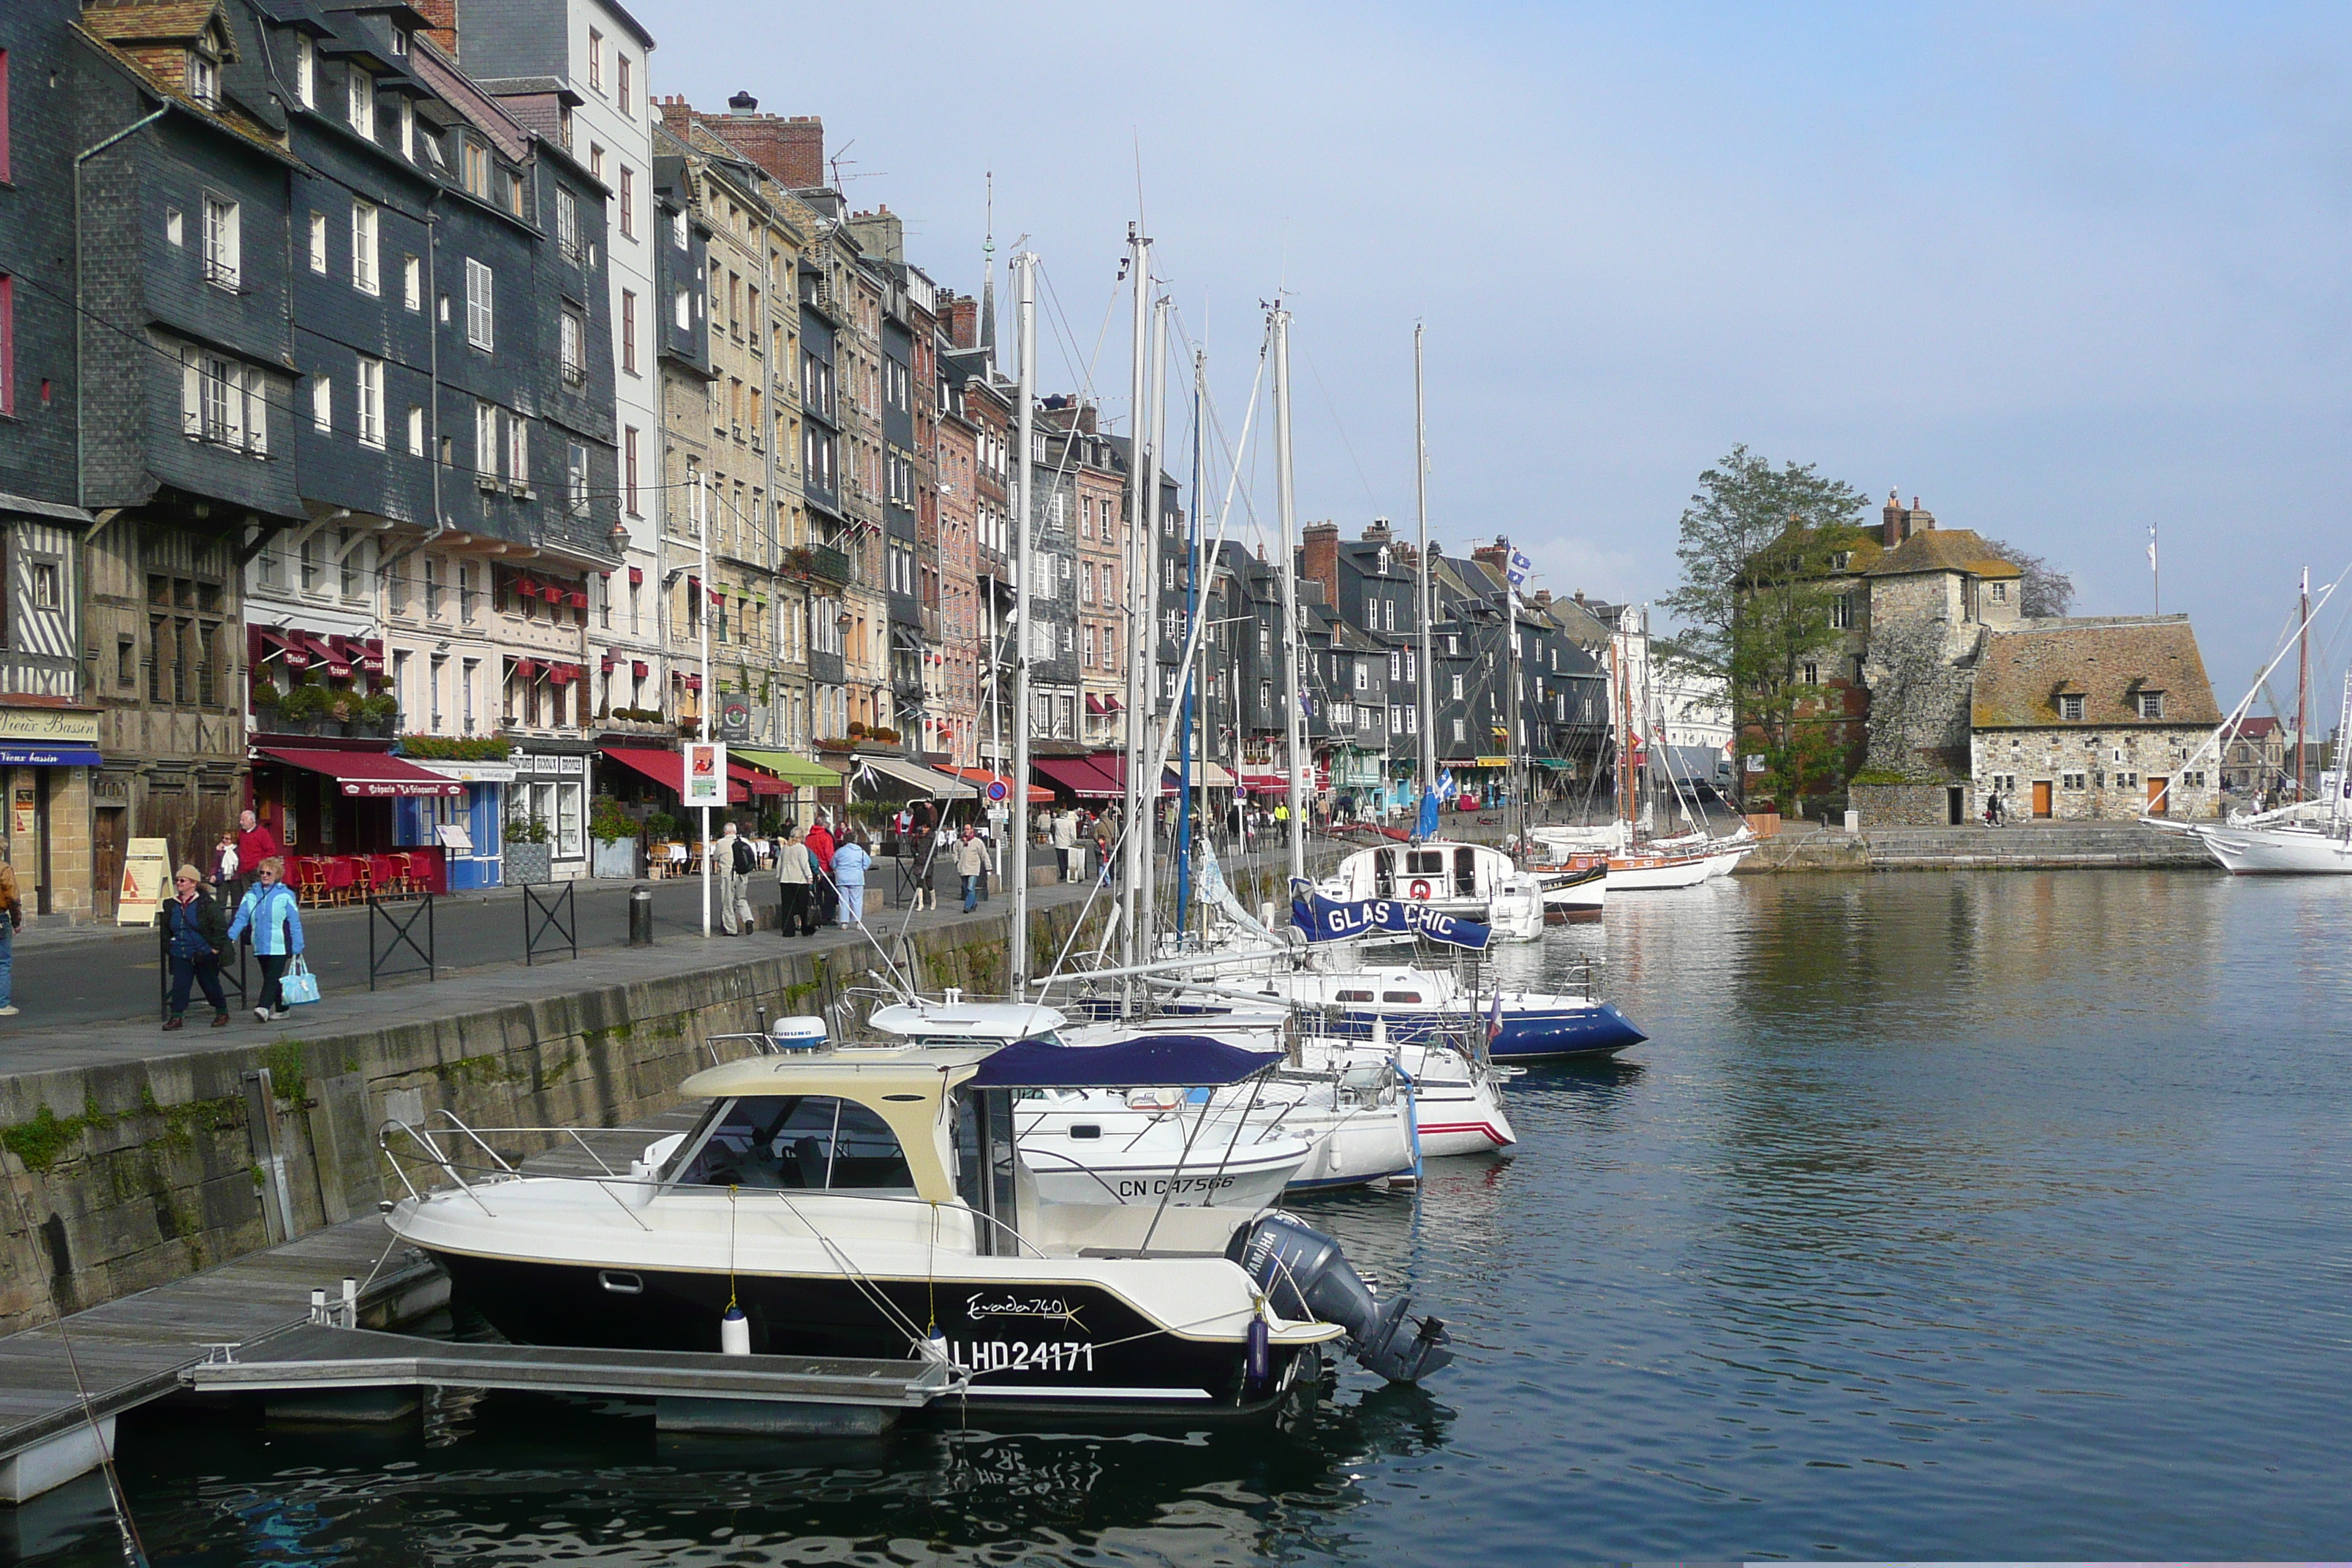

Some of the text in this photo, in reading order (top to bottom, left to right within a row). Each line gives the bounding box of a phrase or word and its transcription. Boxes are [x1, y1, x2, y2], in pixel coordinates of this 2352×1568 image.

[0, 709, 94, 734] Vieux Bassin
[0, 751, 59, 762] Vieux bassin
[537, 758, 557, 770] BIJOUX
[1328, 902, 1457, 935] GLAS CHIC
[1120, 1180, 1147, 1196] CN
[1246, 1231, 1277, 1277] YAMAHA
[953, 1341, 1093, 1371] LHD24171
